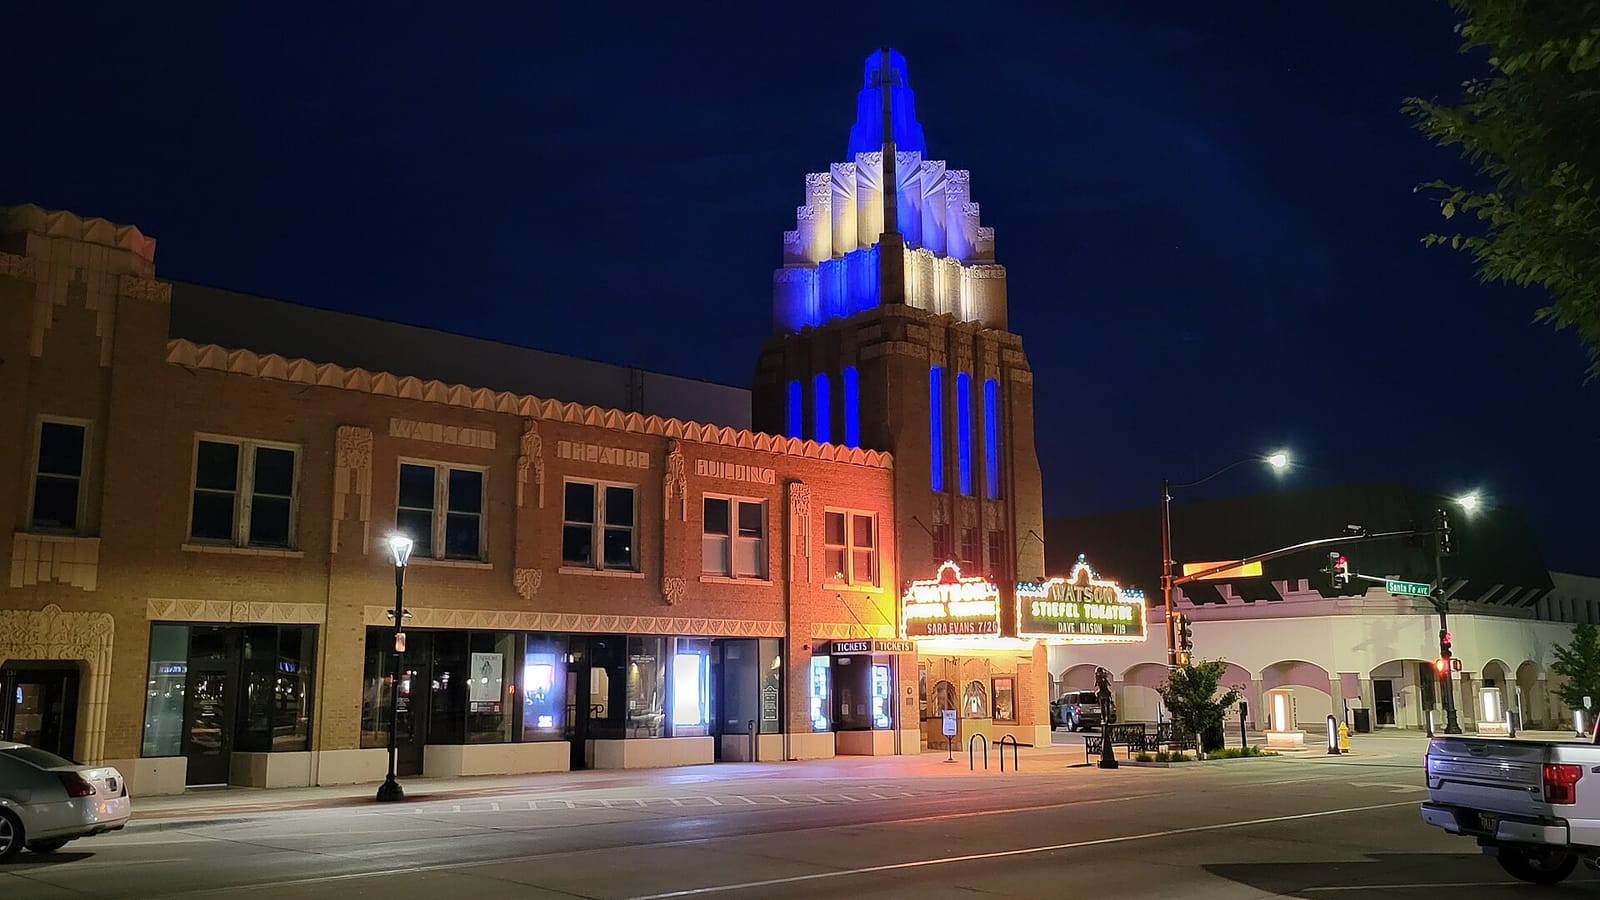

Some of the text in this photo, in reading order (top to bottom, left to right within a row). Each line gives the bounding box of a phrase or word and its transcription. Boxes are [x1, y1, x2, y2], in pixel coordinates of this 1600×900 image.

[557, 440, 650, 469] THEATRE
[695, 459, 776, 485] BUILDING
[1051, 584, 1114, 604] WATSON
[1390, 582, 1407, 593] Santa
[1408, 584, 1415, 594] Fe
[1031, 601, 1133, 620] STIEFEL THEATRE
[927, 622, 947, 634] SARA
[949, 621, 975, 633] EVANS
[1058, 622, 1126, 634] DAVE MASON 7/19
[837, 641, 868, 652] TICKETS
[880, 641, 910, 652] TICKETS
